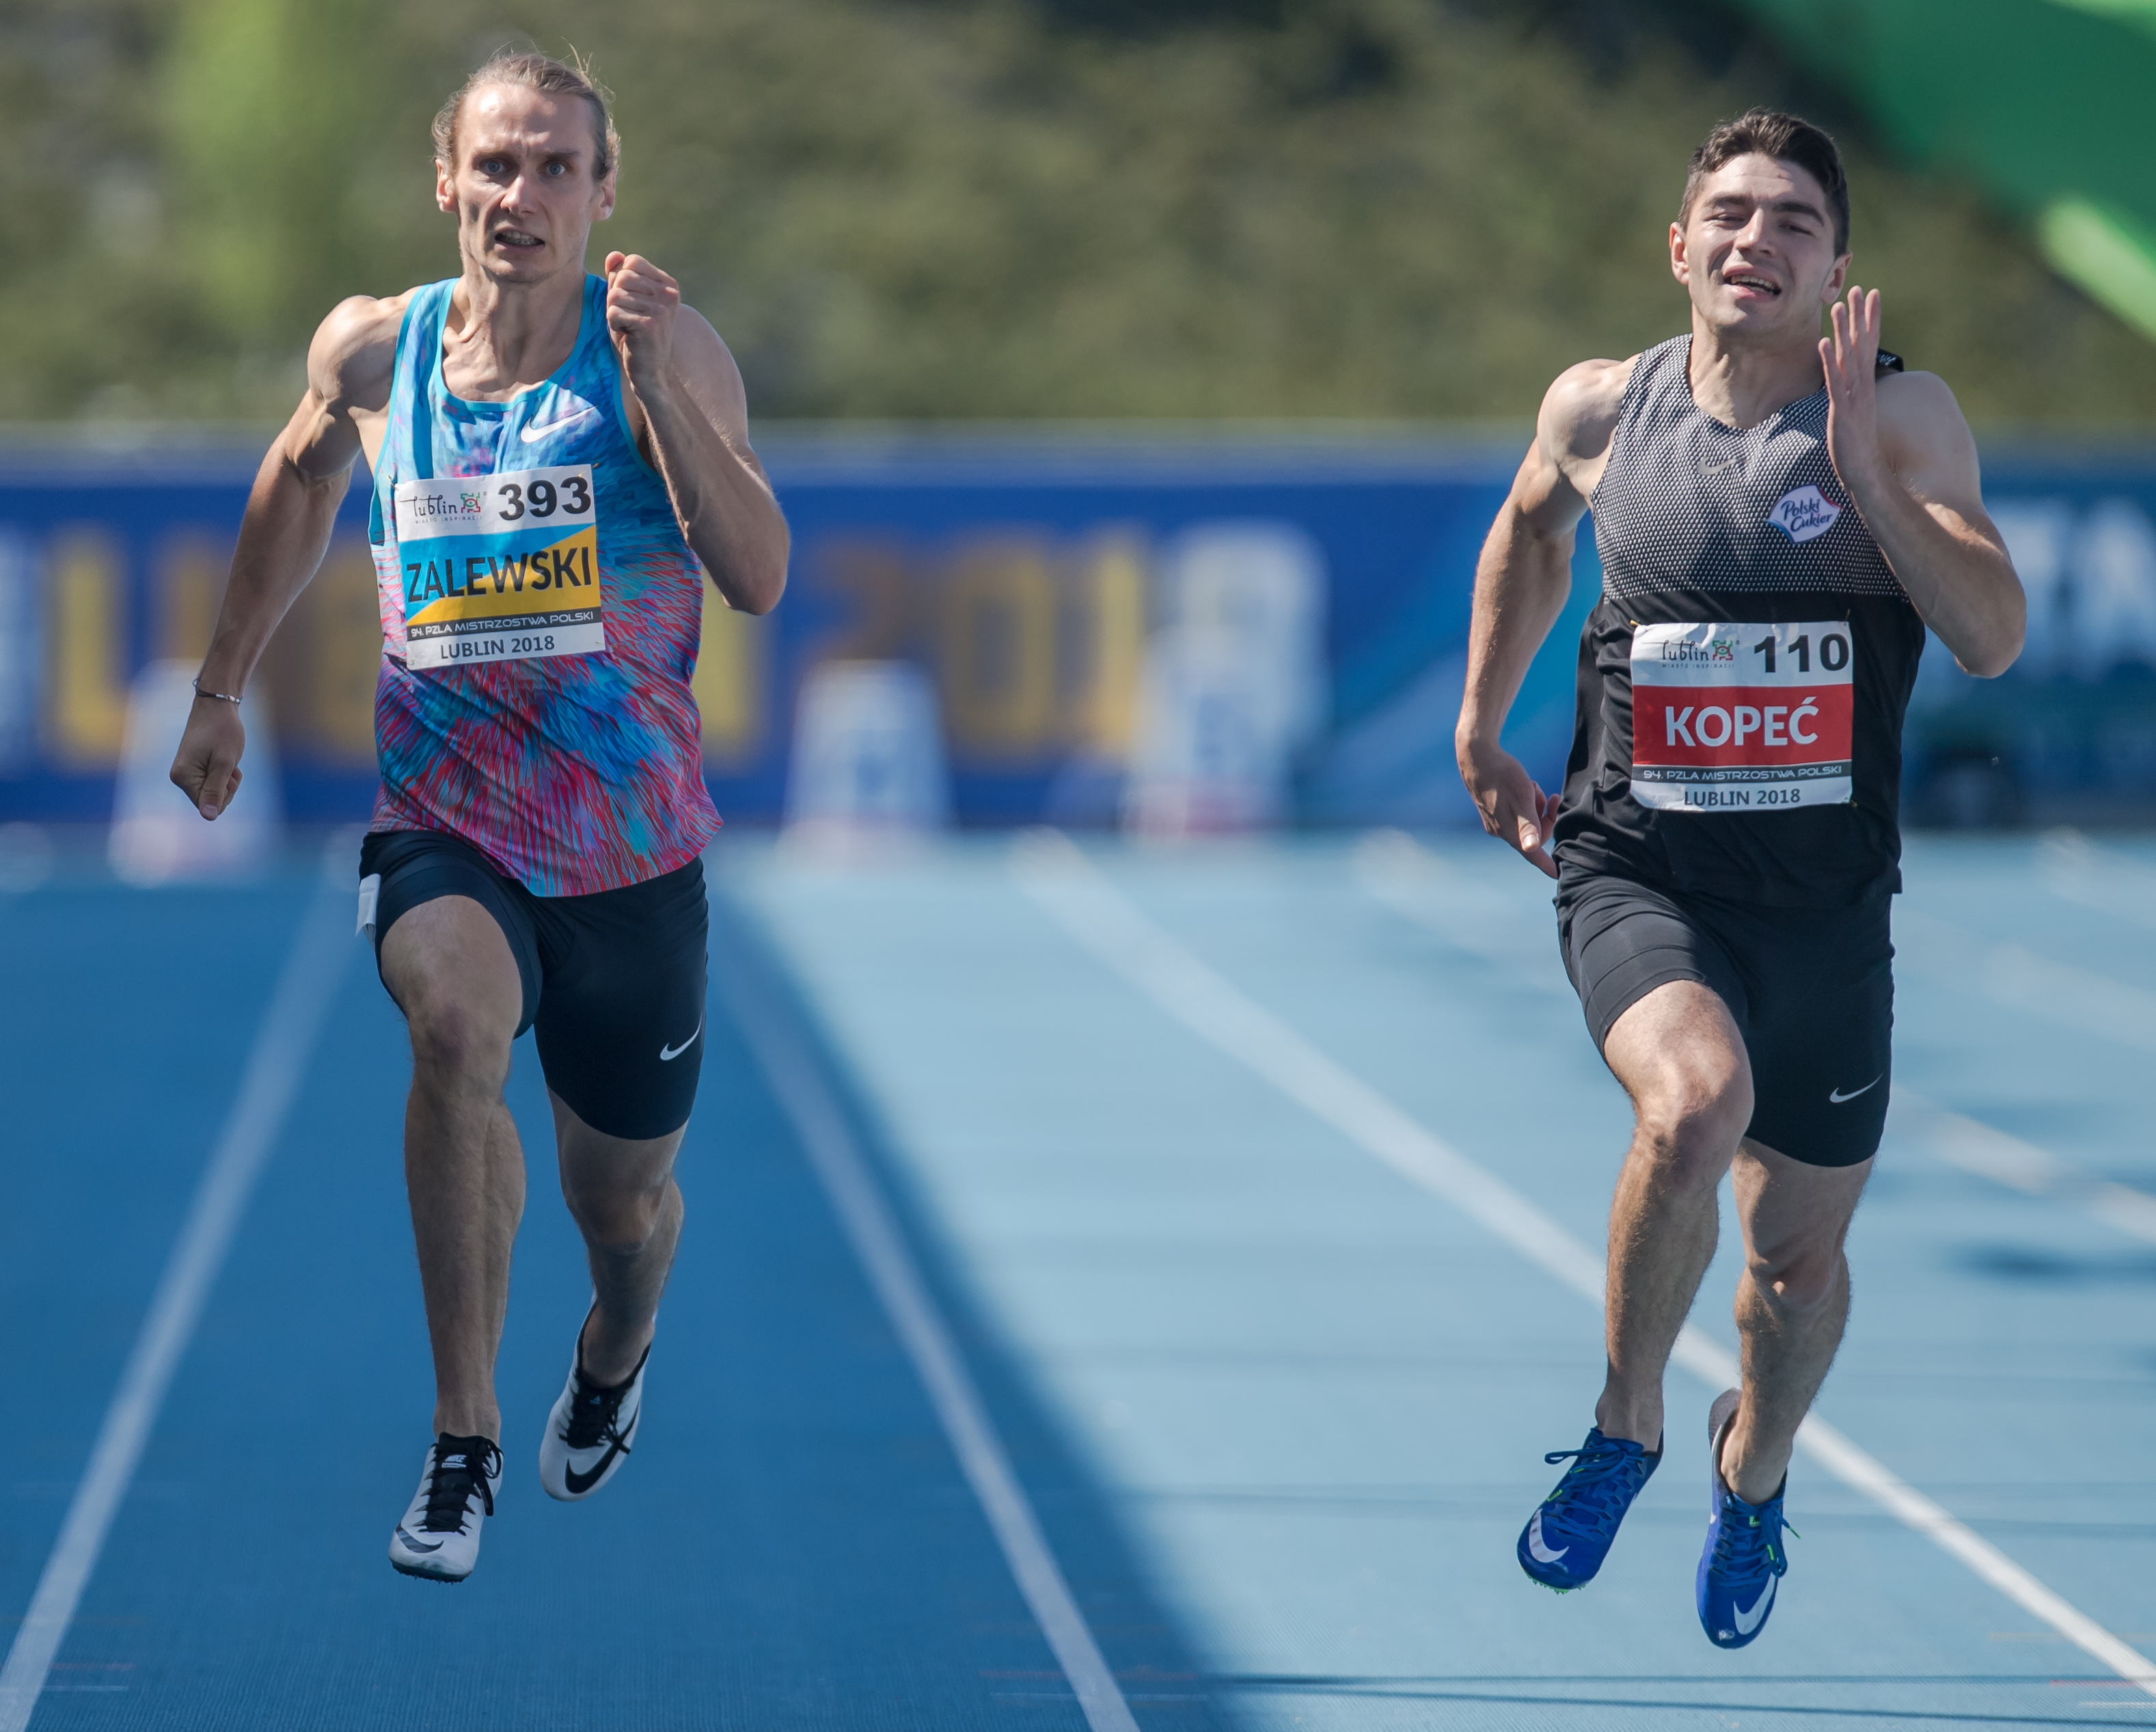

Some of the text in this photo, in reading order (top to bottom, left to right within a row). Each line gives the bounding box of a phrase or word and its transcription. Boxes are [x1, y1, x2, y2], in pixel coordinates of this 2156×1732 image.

[497, 476, 592, 521] 393
[1781, 497, 1820, 520] Polski
[1790, 512, 1833, 532] Cukier
[407, 546, 592, 602] ZALEWSKI
[411, 611, 594, 638] 94. PZLA MISTRZOSTWA POLSKI
[441, 635, 555, 660] LUBLIN 2018
[1754, 633, 1850, 673] 110
[1665, 696, 1819, 747] KOPEĆ
[1643, 765, 1842, 781] 94. PZLA MISTRZOSTWA POLSKI
[1684, 788, 1801, 807] LUBLIN 2018
